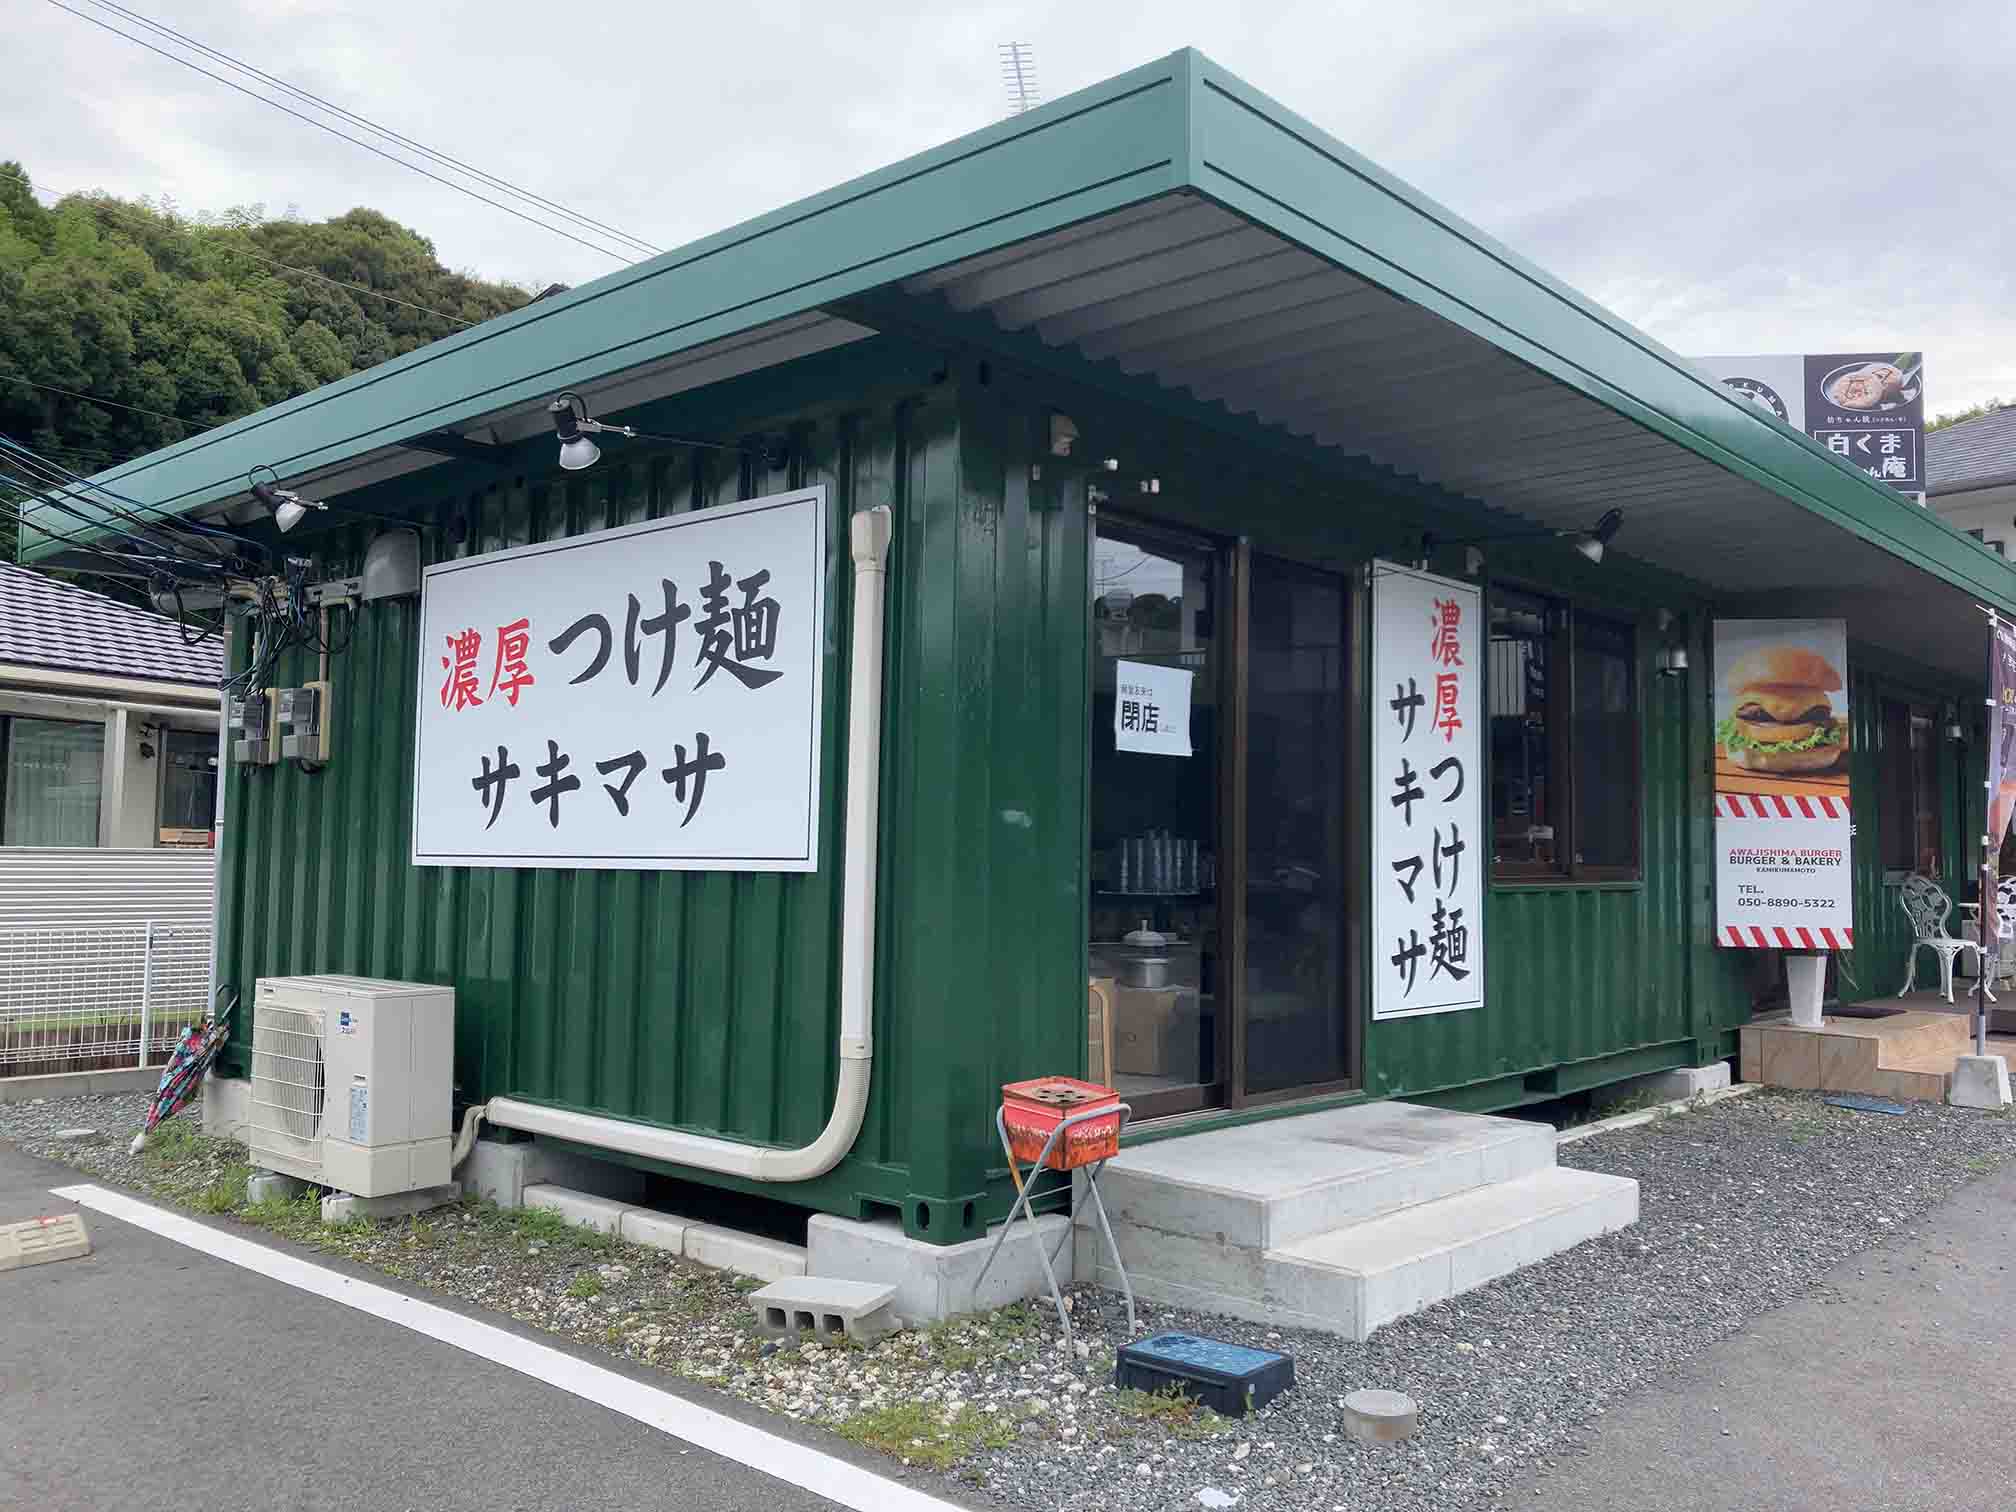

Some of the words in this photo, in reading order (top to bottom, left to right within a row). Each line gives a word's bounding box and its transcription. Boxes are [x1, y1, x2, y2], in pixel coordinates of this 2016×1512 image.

[1828, 433, 1901, 456] 白くま
[440, 560, 784, 712] 濃厚つけ麺
[1121, 700, 1160, 733] 閉店
[471, 732, 726, 831] サキマサ
[1429, 596, 1470, 981] 濃厚つけ麺
[1390, 677, 1427, 999] サキマサ
[1729, 848, 1797, 858] AWAJISHIMA
[1800, 849, 1841, 859] BURGER
[1729, 856, 1776, 865] BURGER
[1781, 857, 1790, 865] &
[1795, 857, 1841, 866] BAKERY
[1738, 885, 1764, 894] TEL.
[1738, 898, 1835, 908] 050-8890-5322
